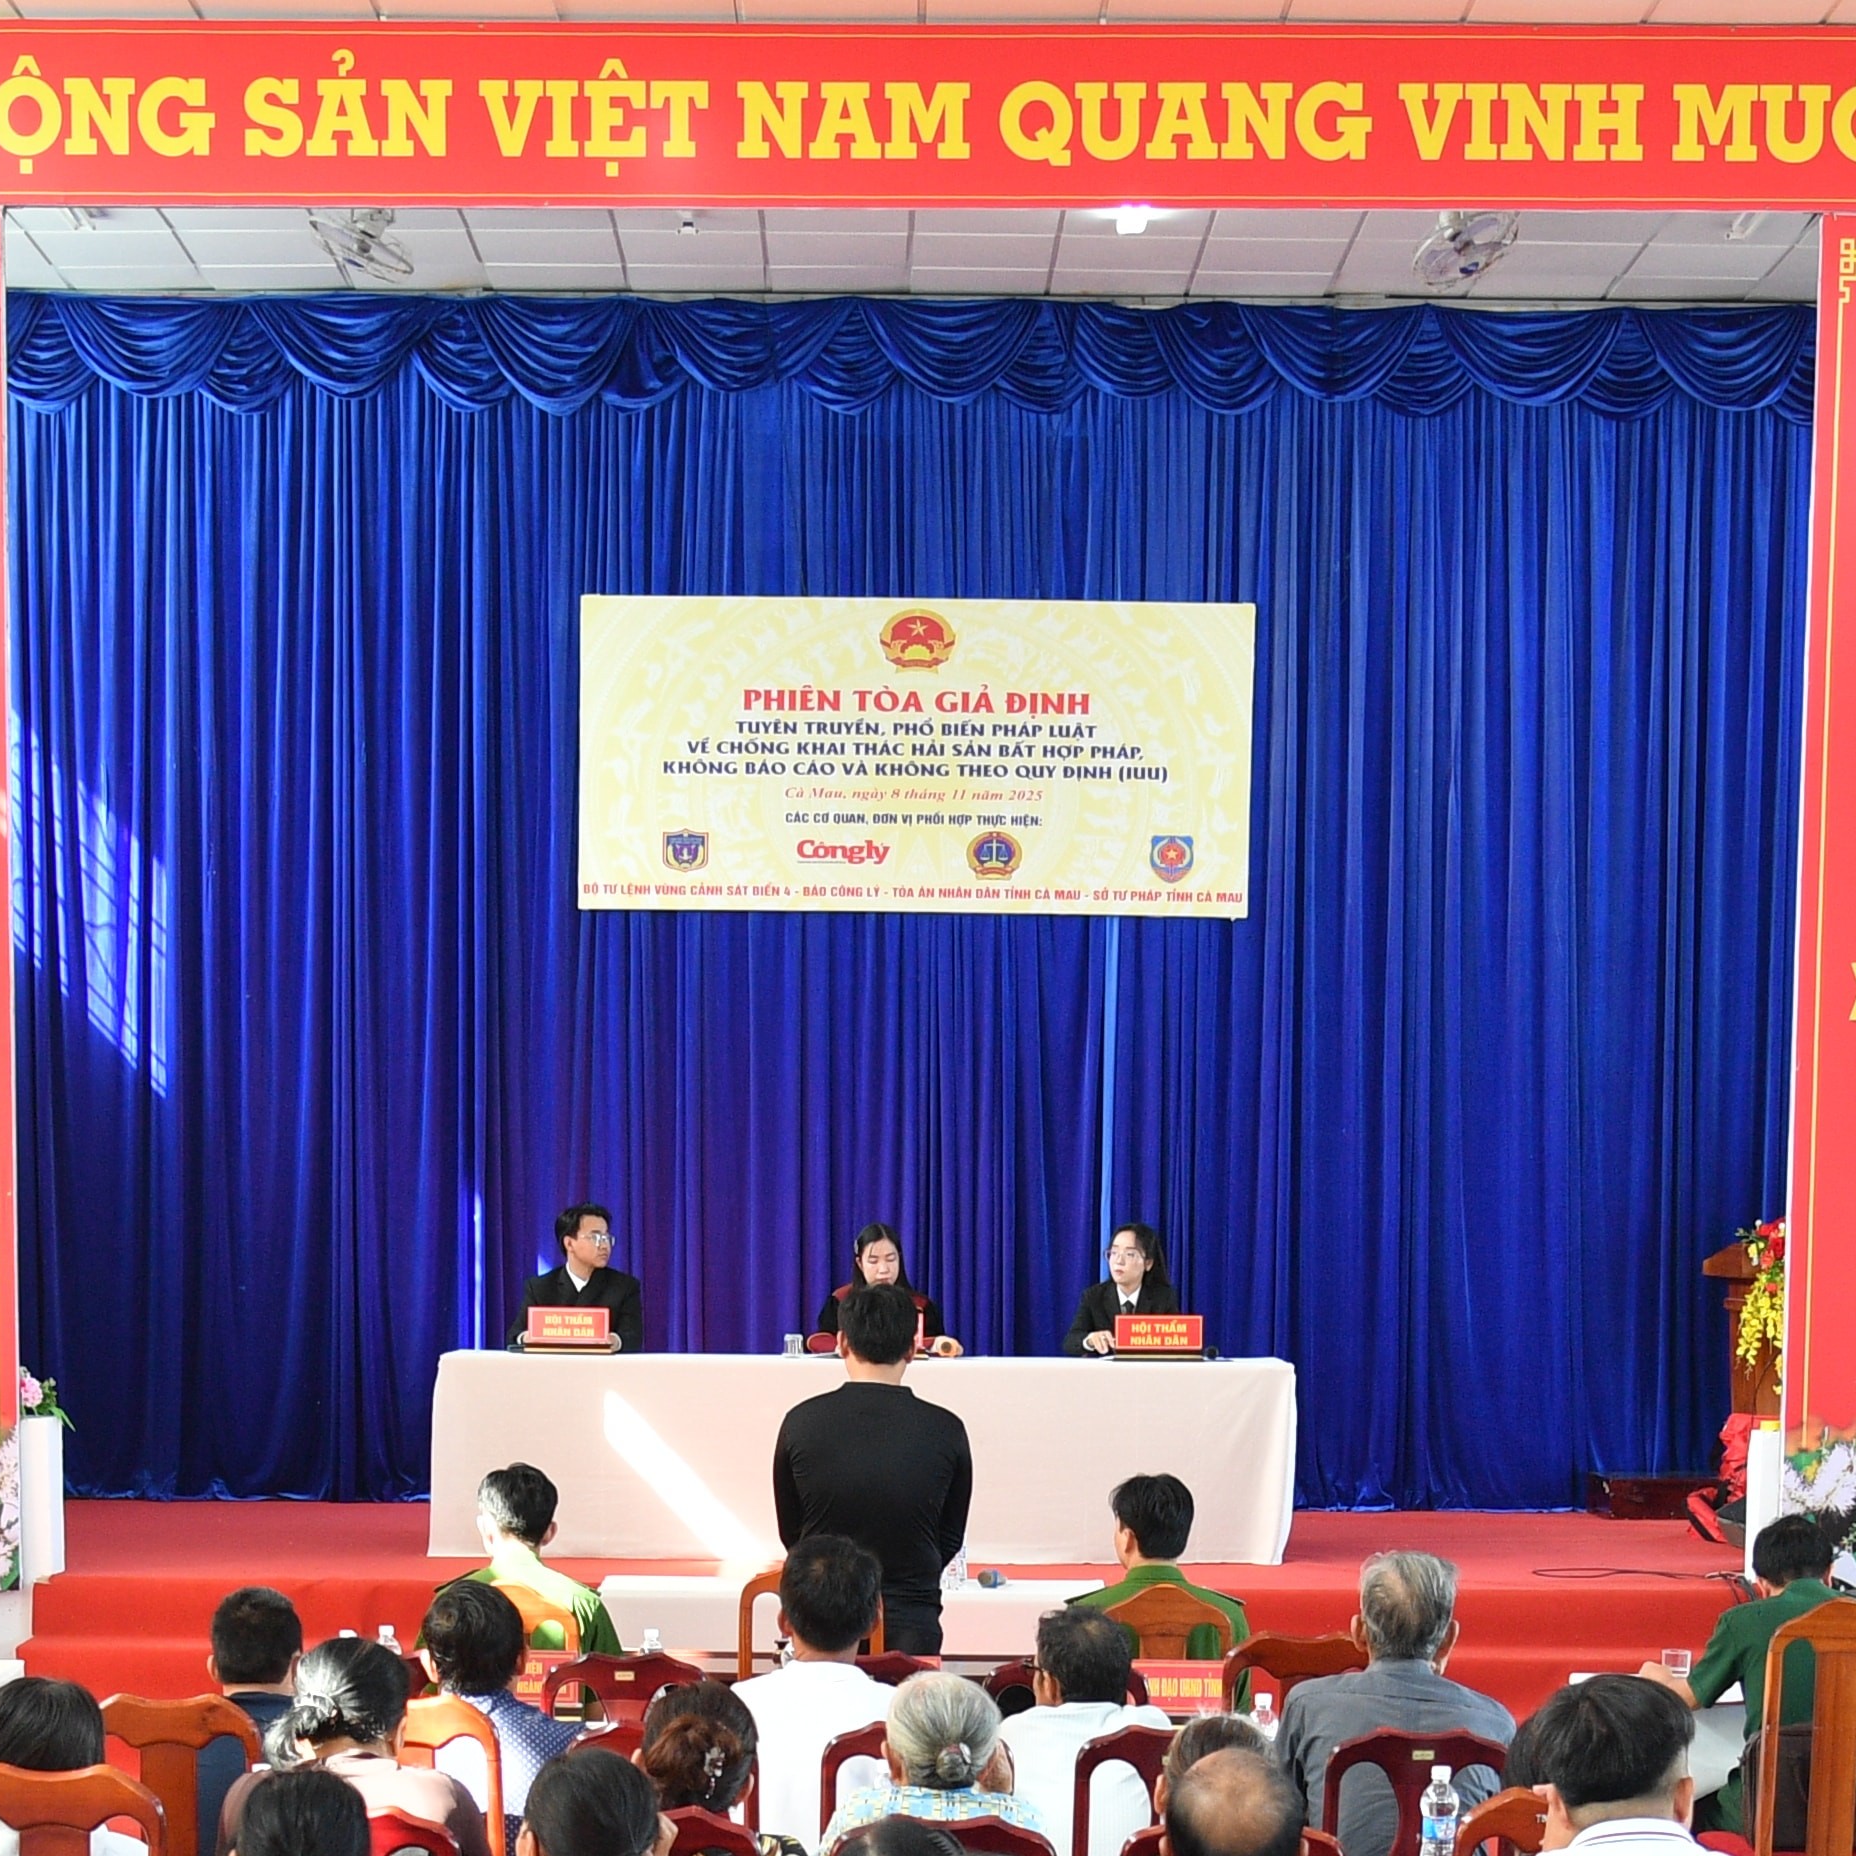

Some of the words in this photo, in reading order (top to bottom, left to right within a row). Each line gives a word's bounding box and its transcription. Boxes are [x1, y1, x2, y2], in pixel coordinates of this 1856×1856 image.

[244, 49, 452, 157] SẢN
[479, 59, 708, 177] VIỆT
[737, 82, 970, 159] NAM
[1000, 81, 1372, 166] QUANG
[1399, 84, 1643, 161] VINH
[743, 685, 841, 712] PHIÊN
[852, 686, 924, 713] TÒA
[935, 684, 994, 714] GIẢ
[1005, 692, 1090, 719] ĐỊNH
[736, 719, 797, 735] TUYÊN
[893, 717, 934, 736] PHỔ
[941, 720, 985, 737] BIẾN
[992, 722, 1042, 738] PHÁP
[1049, 723, 1097, 742] LUẬT
[716, 738, 789, 755] CHỐNG
[797, 742, 845, 755] KHAI
[852, 740, 905, 756] THÁC
[911, 739, 945, 757] HẢI
[952, 740, 992, 757] SẢN
[998, 741, 1036, 758] BẤT
[1043, 744, 1084, 762] HỢP
[1090, 744, 1145, 761] PHÁP,
[663, 759, 738, 775] KHÔNG
[745, 759, 786, 776] BÁO
[793, 760, 835, 776] CÁO
[842, 760, 868, 776] VÀ
[875, 761, 950, 777] KHÔNG
[956, 764, 1008, 777] THEO
[1015, 765, 1056, 780] QUY
[1063, 766, 1112, 782] ĐỊNH
[1118, 766, 1169, 784] (IUU)
